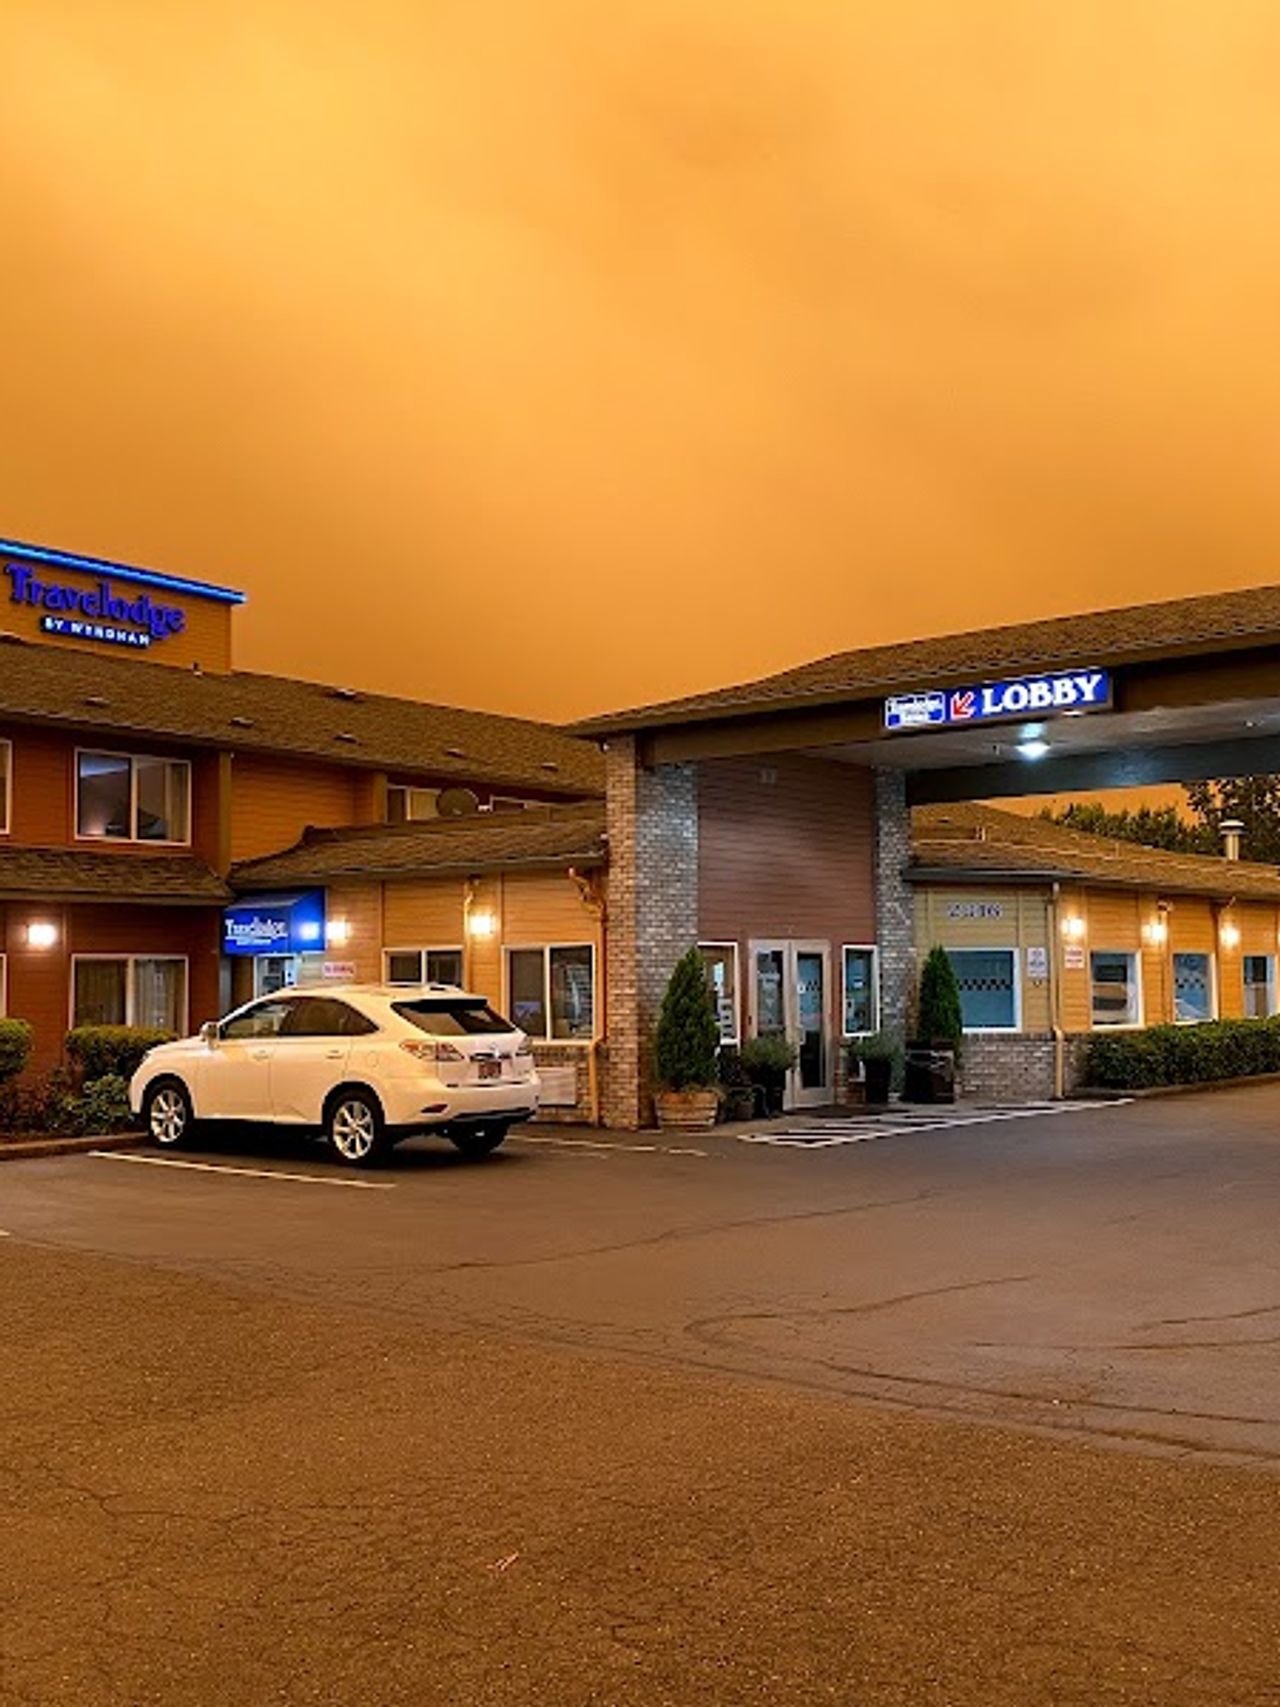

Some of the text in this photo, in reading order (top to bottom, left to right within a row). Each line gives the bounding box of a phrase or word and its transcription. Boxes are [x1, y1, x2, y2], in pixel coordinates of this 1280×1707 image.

[5, 562, 186, 639] Travelodge
[44, 617, 64, 631] BY
[982, 674, 1102, 713] LOBBY
